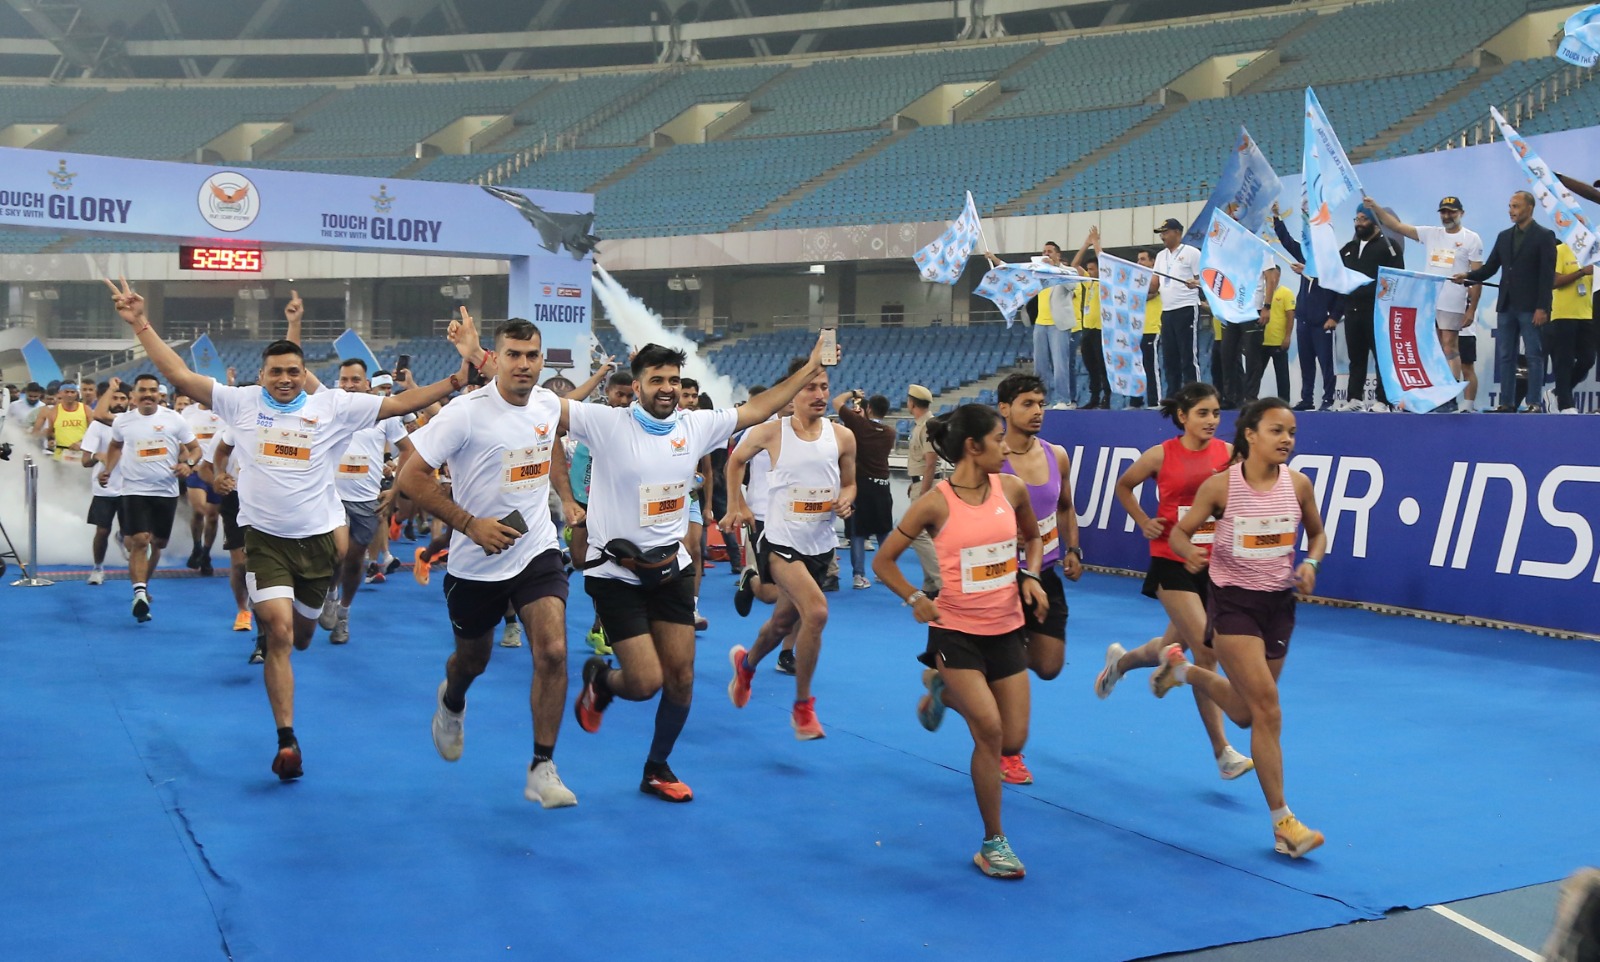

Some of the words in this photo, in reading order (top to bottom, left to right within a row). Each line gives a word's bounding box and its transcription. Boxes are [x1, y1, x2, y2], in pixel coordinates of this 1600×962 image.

[0, 190, 44, 208] OUCH
[48, 194, 132, 223] GLORY
[5, 208, 21, 216] SKY
[23, 210, 44, 218] WITH
[321, 213, 368, 230] TOUCH
[321, 230, 333, 238] THE
[334, 230, 347, 238] SKY
[371, 217, 442, 243] GLORY
[192, 248, 260, 270] 5:29:55
[534, 303, 586, 323] TAKEOFF
[1393, 311, 1403, 340] FIRST
[1395, 342, 1406, 365] IDFC
[1404, 341, 1416, 364] Bank
[274, 444, 298, 456] 29084
[520, 463, 542, 477] 24002
[1069, 446, 1144, 533] UN
[1429, 461, 1600, 584] INS
